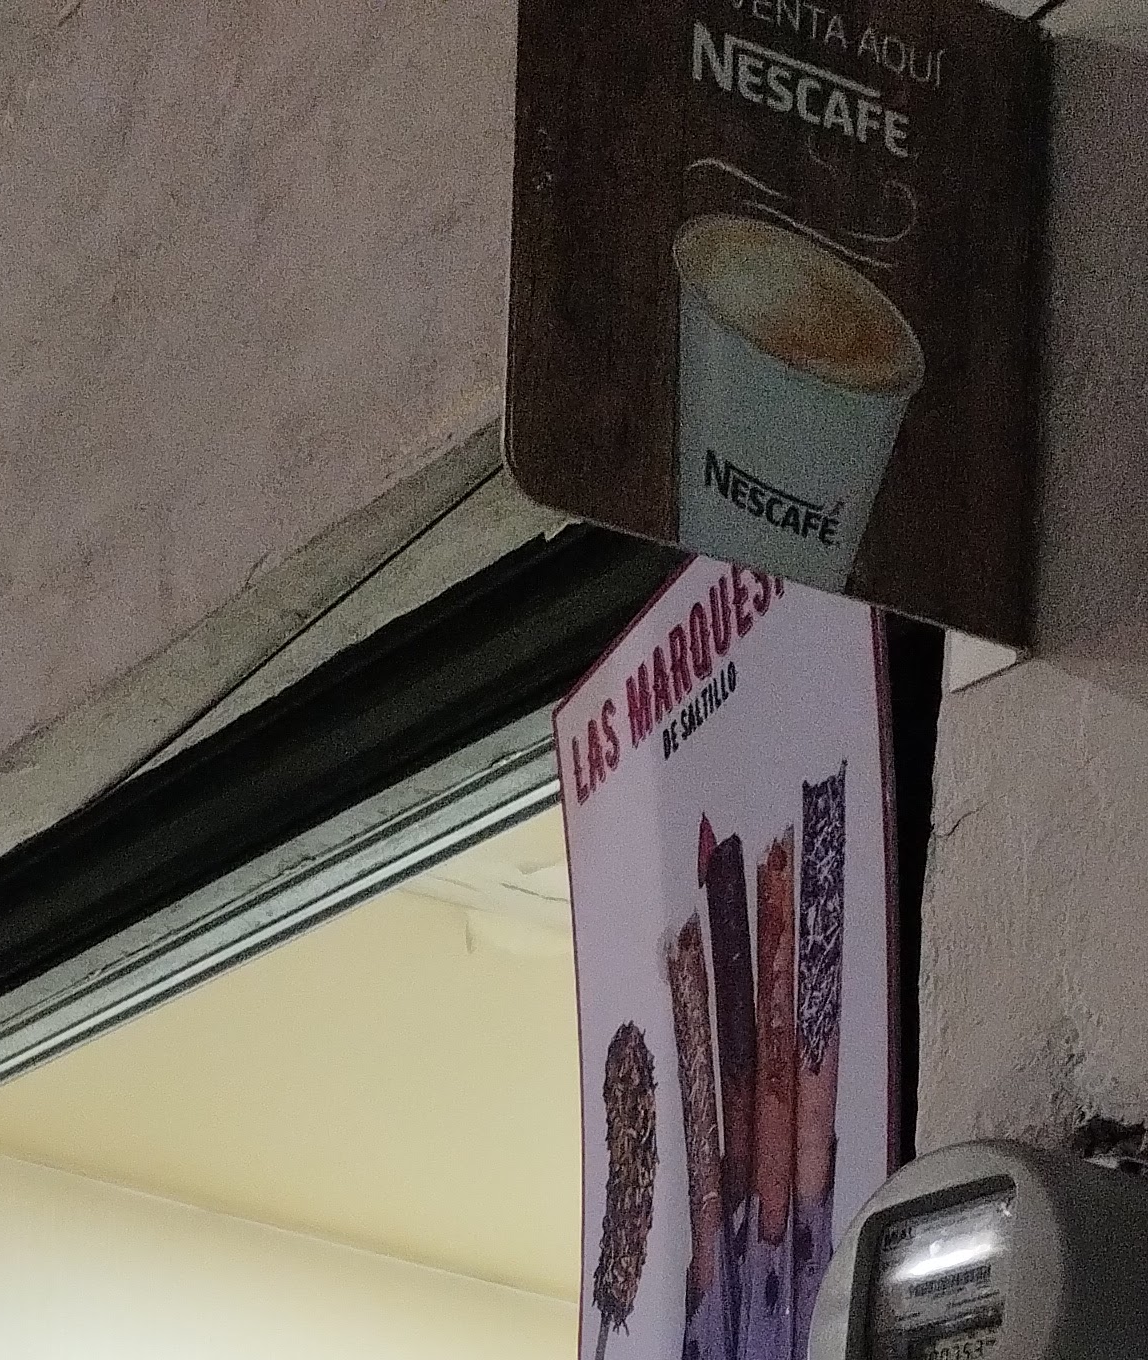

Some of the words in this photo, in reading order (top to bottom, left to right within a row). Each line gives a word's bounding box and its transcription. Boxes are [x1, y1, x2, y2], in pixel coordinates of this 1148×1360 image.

[731, 0, 848, 50] ENTA
[572, 697, 619, 804] LAS
[626, 564, 784, 749] MARQUES
[662, 720, 679, 760] DE
[680, 661, 737, 741] SALTILLO
